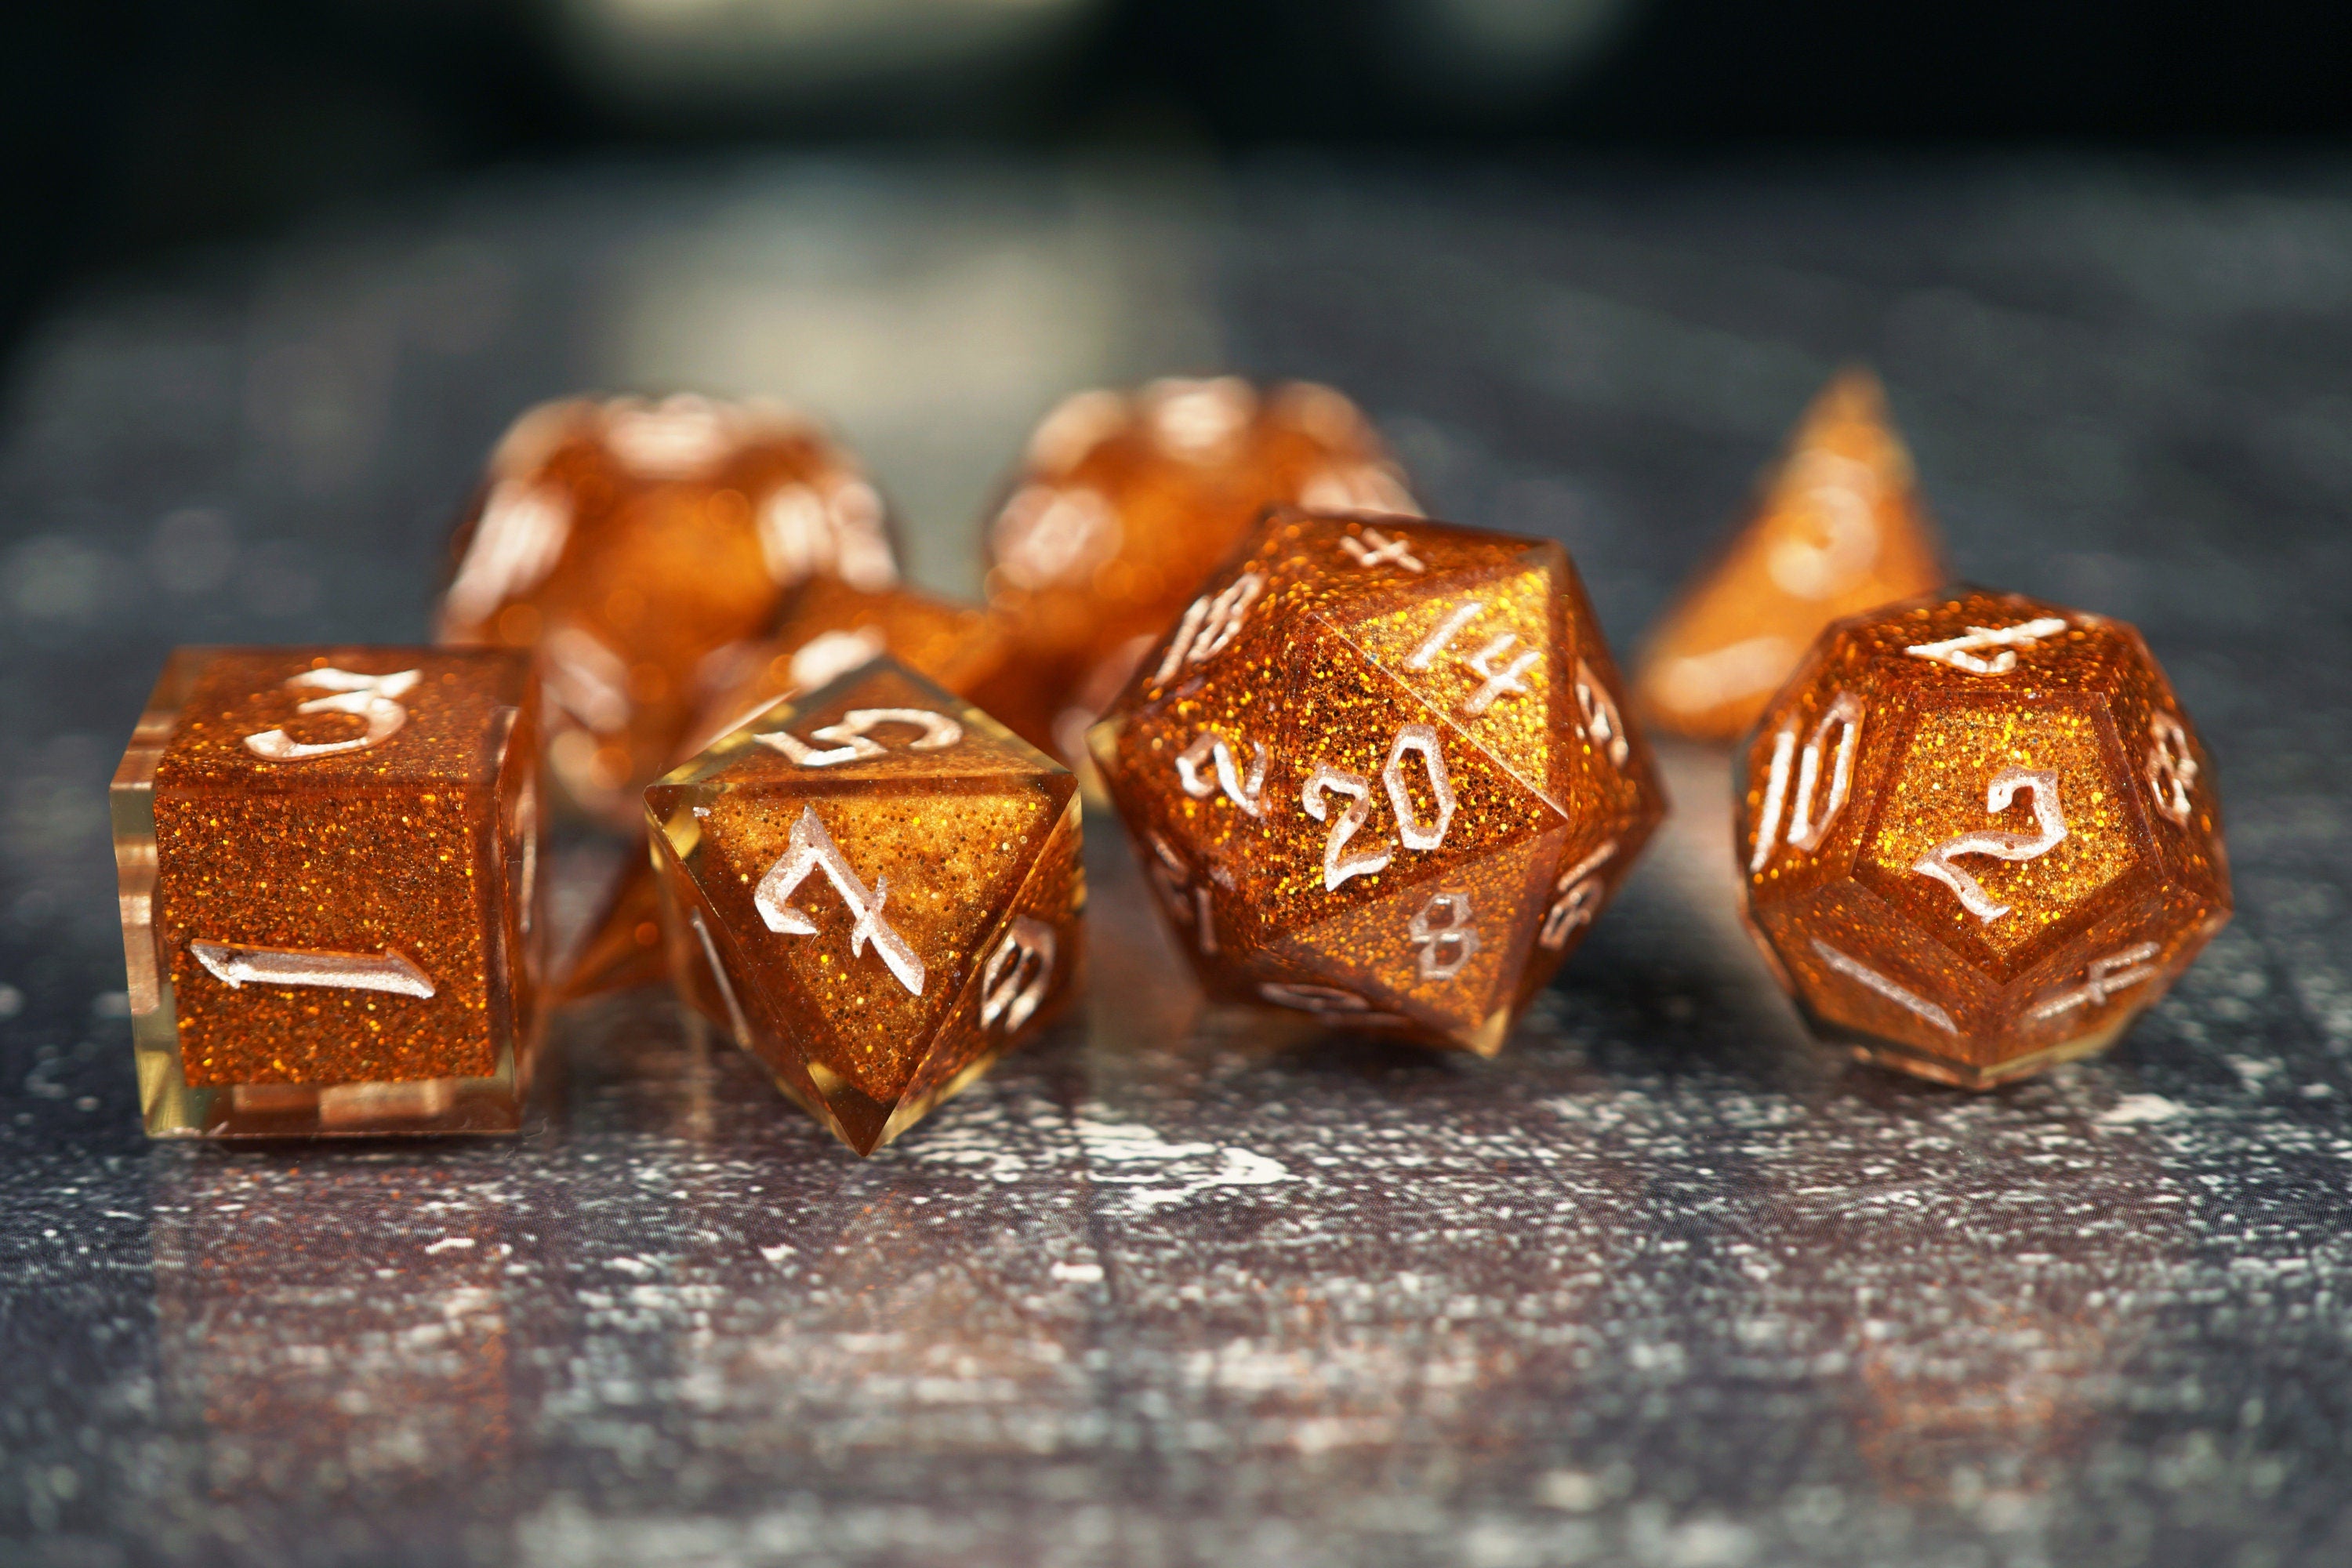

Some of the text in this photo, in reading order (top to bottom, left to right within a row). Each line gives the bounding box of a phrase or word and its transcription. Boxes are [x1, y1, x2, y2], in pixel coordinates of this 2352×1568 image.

[1340, 528, 1427, 573] 4
[1404, 601, 1544, 717] 14
[1904, 617, 2067, 677] 7
[243, 667, 423, 761] 3
[753, 708, 963, 767] 5
[1175, 732, 1270, 818] 2
[1301, 724, 1457, 892] 20
[1750, 693, 1865, 873] 10
[2146, 711, 2198, 827] 8
[1911, 764, 2068, 925] 2
[753, 803, 926, 996] 7
[1408, 891, 1479, 982] 8
[189, 938, 436, 1000] 1
[2029, 941, 2161, 1021] 4
